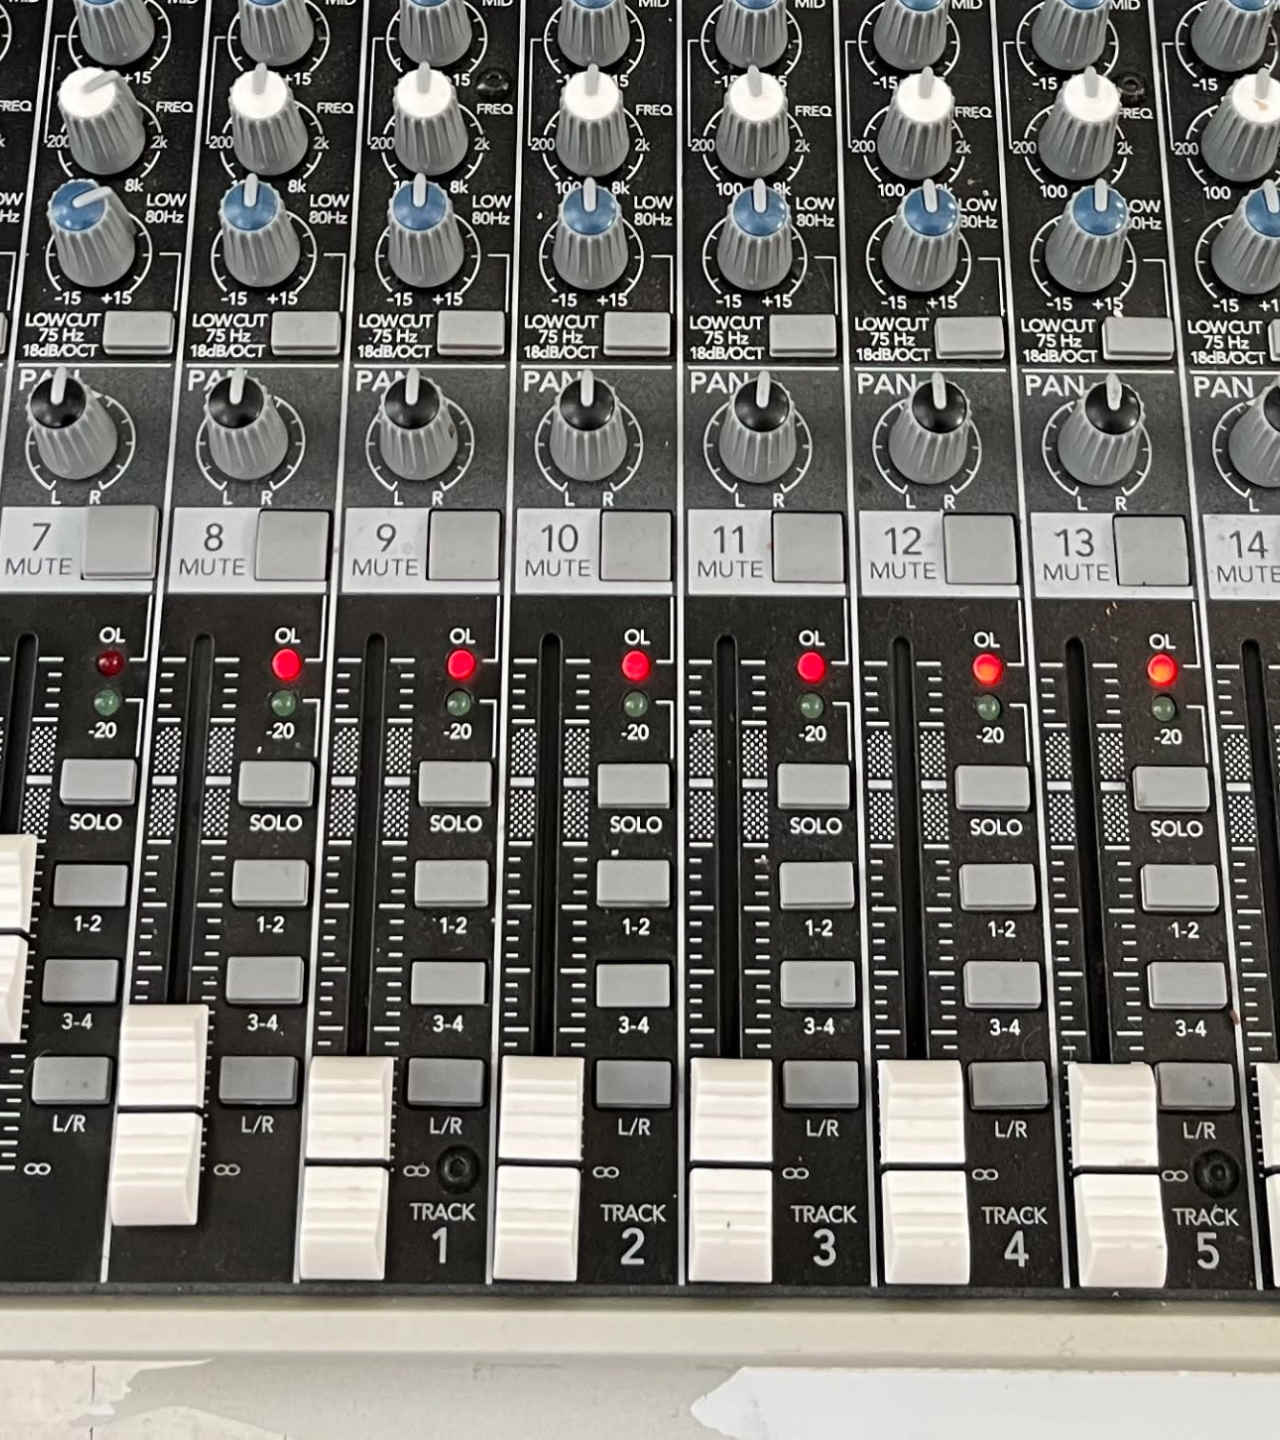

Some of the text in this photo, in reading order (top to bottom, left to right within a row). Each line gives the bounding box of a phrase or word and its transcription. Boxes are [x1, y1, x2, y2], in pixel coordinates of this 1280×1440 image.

[206, 328, 251, 343] 75 Hz
[190, 343, 266, 358] 18dB/OCT
[1194, 376, 1253, 398] PAN
[33, 523, 51, 551] 7
[542, 524, 578, 552] 10
[885, 527, 921, 555] 12
[6, 558, 72, 575] MUTE
[526, 560, 590, 576] MUTE
[871, 562, 936, 579] MUTE
[450, 628, 475, 644] OL
[791, 817, 842, 834] SOLO
[1172, 922, 1199, 938] 1-2
[1176, 1020, 1206, 1036] 3-4
[1184, 1122, 1216, 1139] L/R
[601, 1204, 666, 1222] TRACK
[621, 1228, 644, 1264] 2
